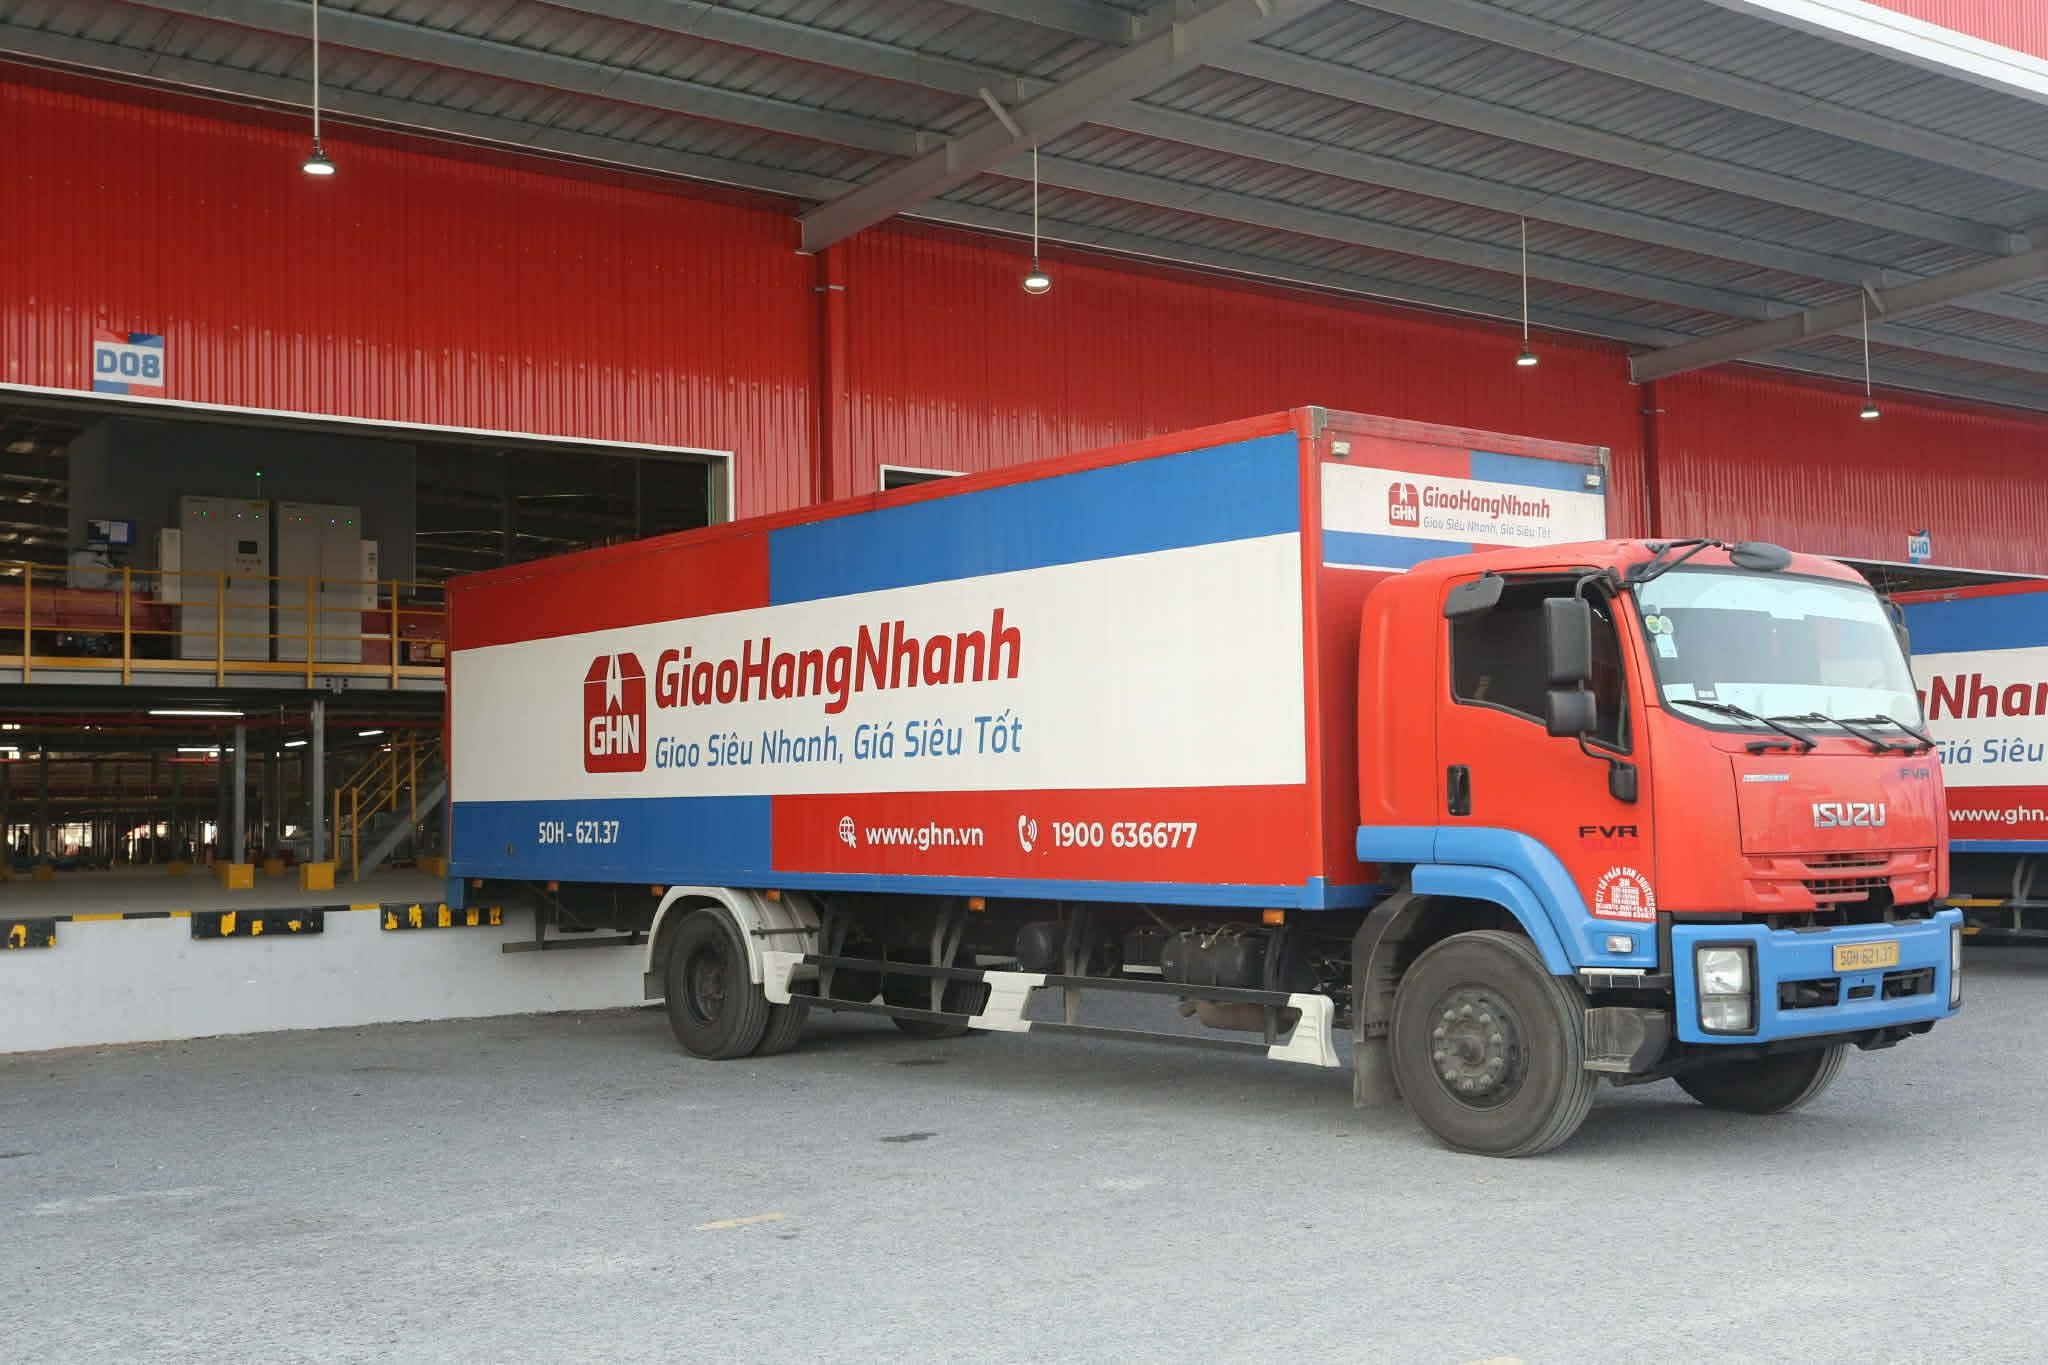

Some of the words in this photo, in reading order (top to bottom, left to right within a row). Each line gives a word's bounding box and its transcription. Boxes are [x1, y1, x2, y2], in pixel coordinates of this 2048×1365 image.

[96, 349, 160, 378] D08
[1391, 505, 1417, 521] GHN
[1423, 486, 1550, 519] GiaoHangNhanh
[1423, 516, 1444, 529] Giao
[655, 608, 1021, 714] GiaoHangNhanh
[1917, 673, 2048, 720] Nha
[589, 714, 640, 756] GHN
[655, 736, 700, 769] Giao
[707, 732, 753, 767] Siêu
[760, 725, 843, 765] Nhanh,
[854, 721, 894, 760] Giá
[904, 718, 963, 757] Siêu
[975, 708, 1022, 754] Tốt
[1983, 737, 2044, 763] Siêu
[1901, 768, 1929, 780] FVR
[1812, 803, 1886, 828] ISUZU
[538, 821, 564, 844] 50H
[576, 821, 619, 844] 621.37
[866, 822, 984, 850] www.ghn.vn
[1052, 822, 1104, 848] 1900
[1111, 822, 1197, 849] 636677
[1579, 825, 1638, 838] FVR
